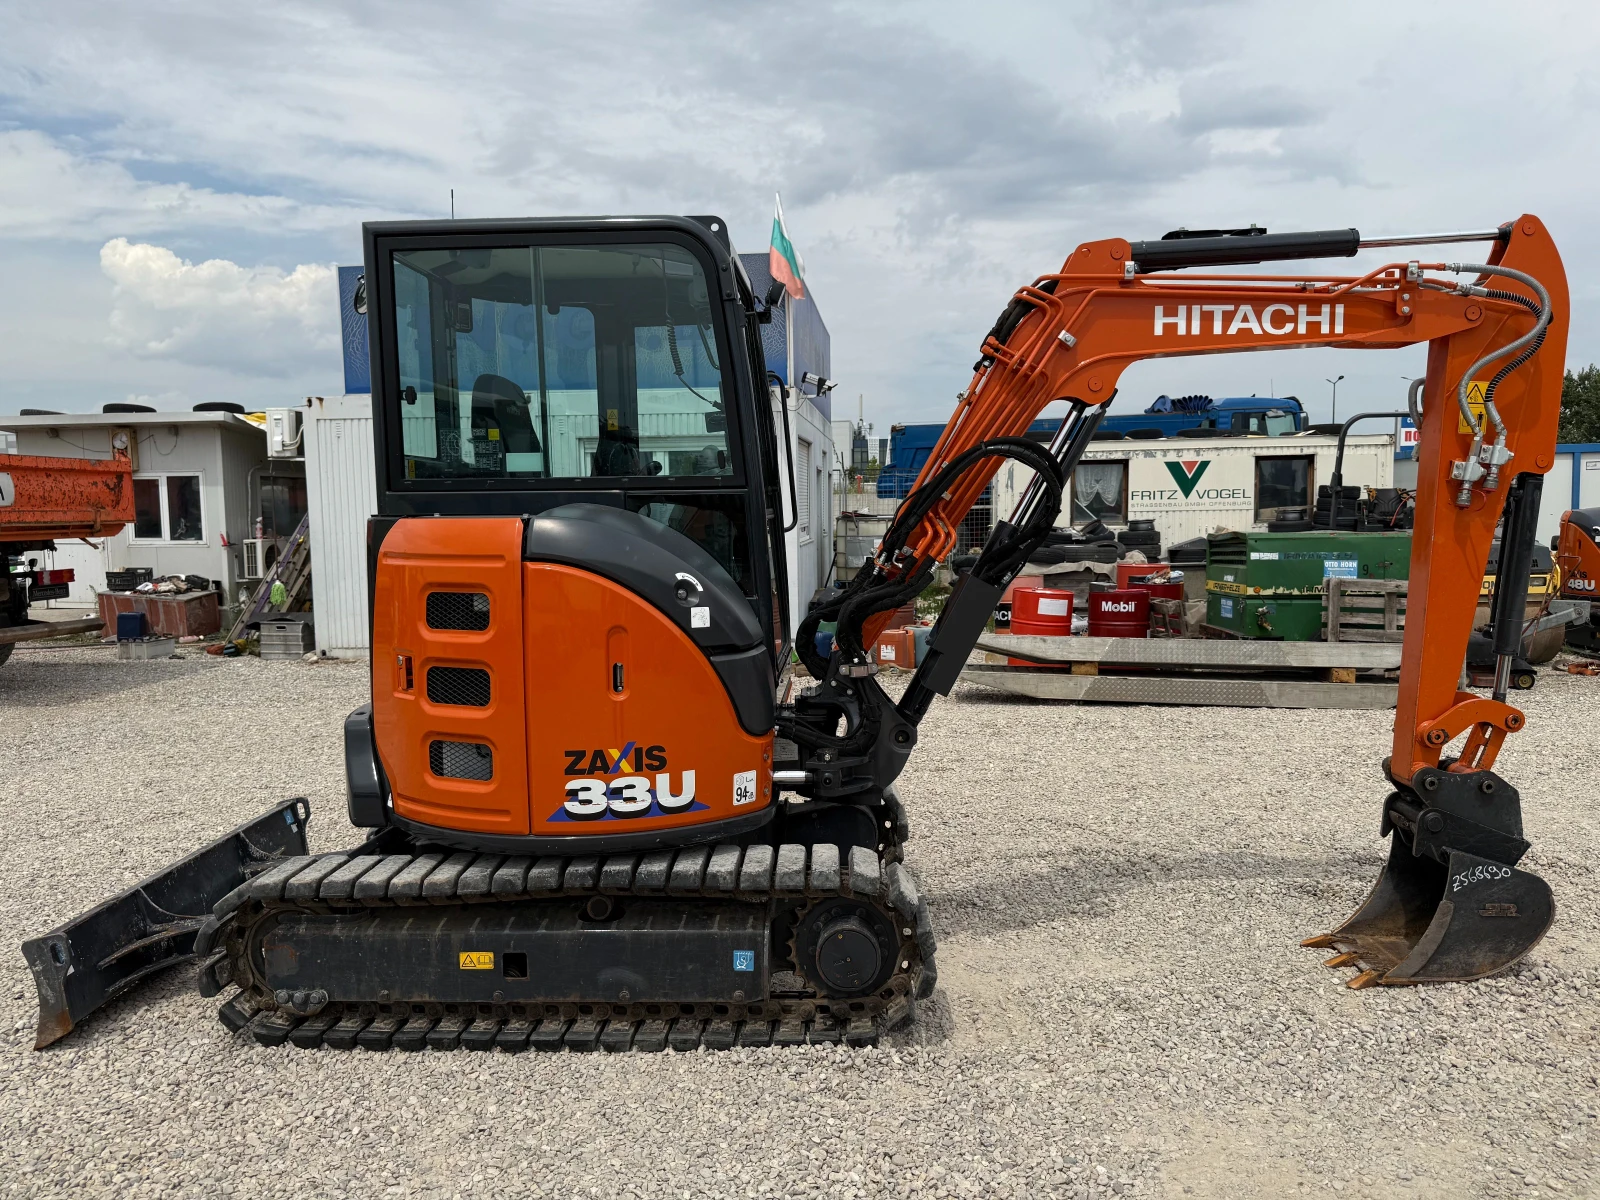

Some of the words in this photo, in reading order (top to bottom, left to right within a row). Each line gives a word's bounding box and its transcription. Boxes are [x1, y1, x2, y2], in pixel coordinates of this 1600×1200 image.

[1153, 303, 1345, 336] HITACHI
[1131, 490, 1179, 501] FRITZ
[1195, 488, 1252, 500] VOGEL
[1362, 564, 1369, 576] 9
[1567, 579, 1596, 591] 48U
[1101, 601, 1135, 613] Mobil
[564, 741, 668, 775] ZAXIS
[563, 769, 696, 821] 33U
[1452, 864, 1512, 893] 2568690
